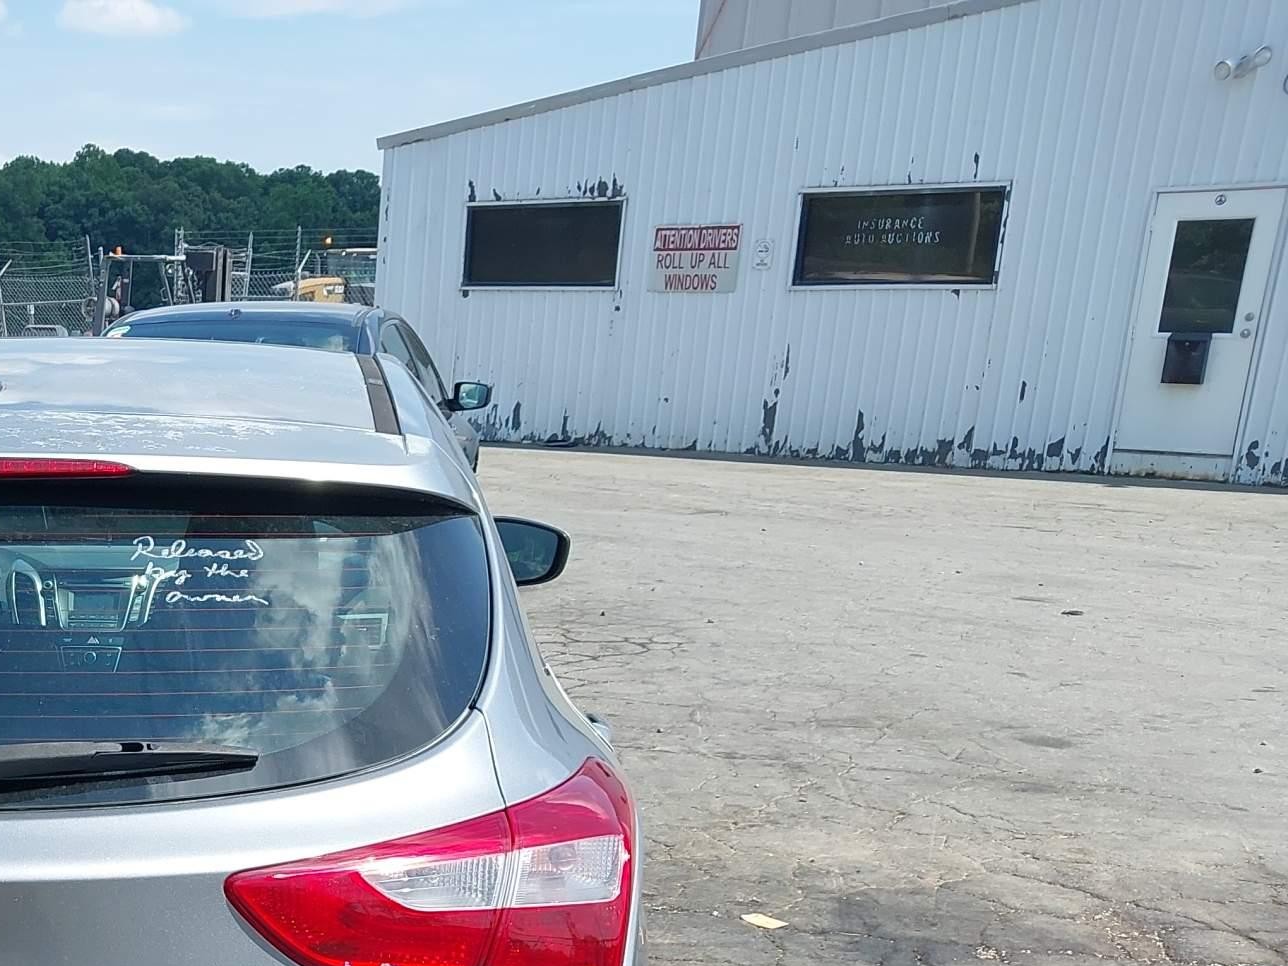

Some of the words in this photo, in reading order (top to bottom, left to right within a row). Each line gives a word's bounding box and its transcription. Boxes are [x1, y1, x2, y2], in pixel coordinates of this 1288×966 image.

[857, 216, 925, 230] INSURANCE
[655, 229, 699, 249] ATTENTION
[700, 227, 738, 249] DRIVERS
[656, 253, 684, 269] ROLL
[690, 252, 705, 269] UP
[708, 252, 729, 269] ALL
[664, 274, 718, 291] WINDOWS
[130, 535, 264, 561] Released
[204, 562, 249, 578] the
